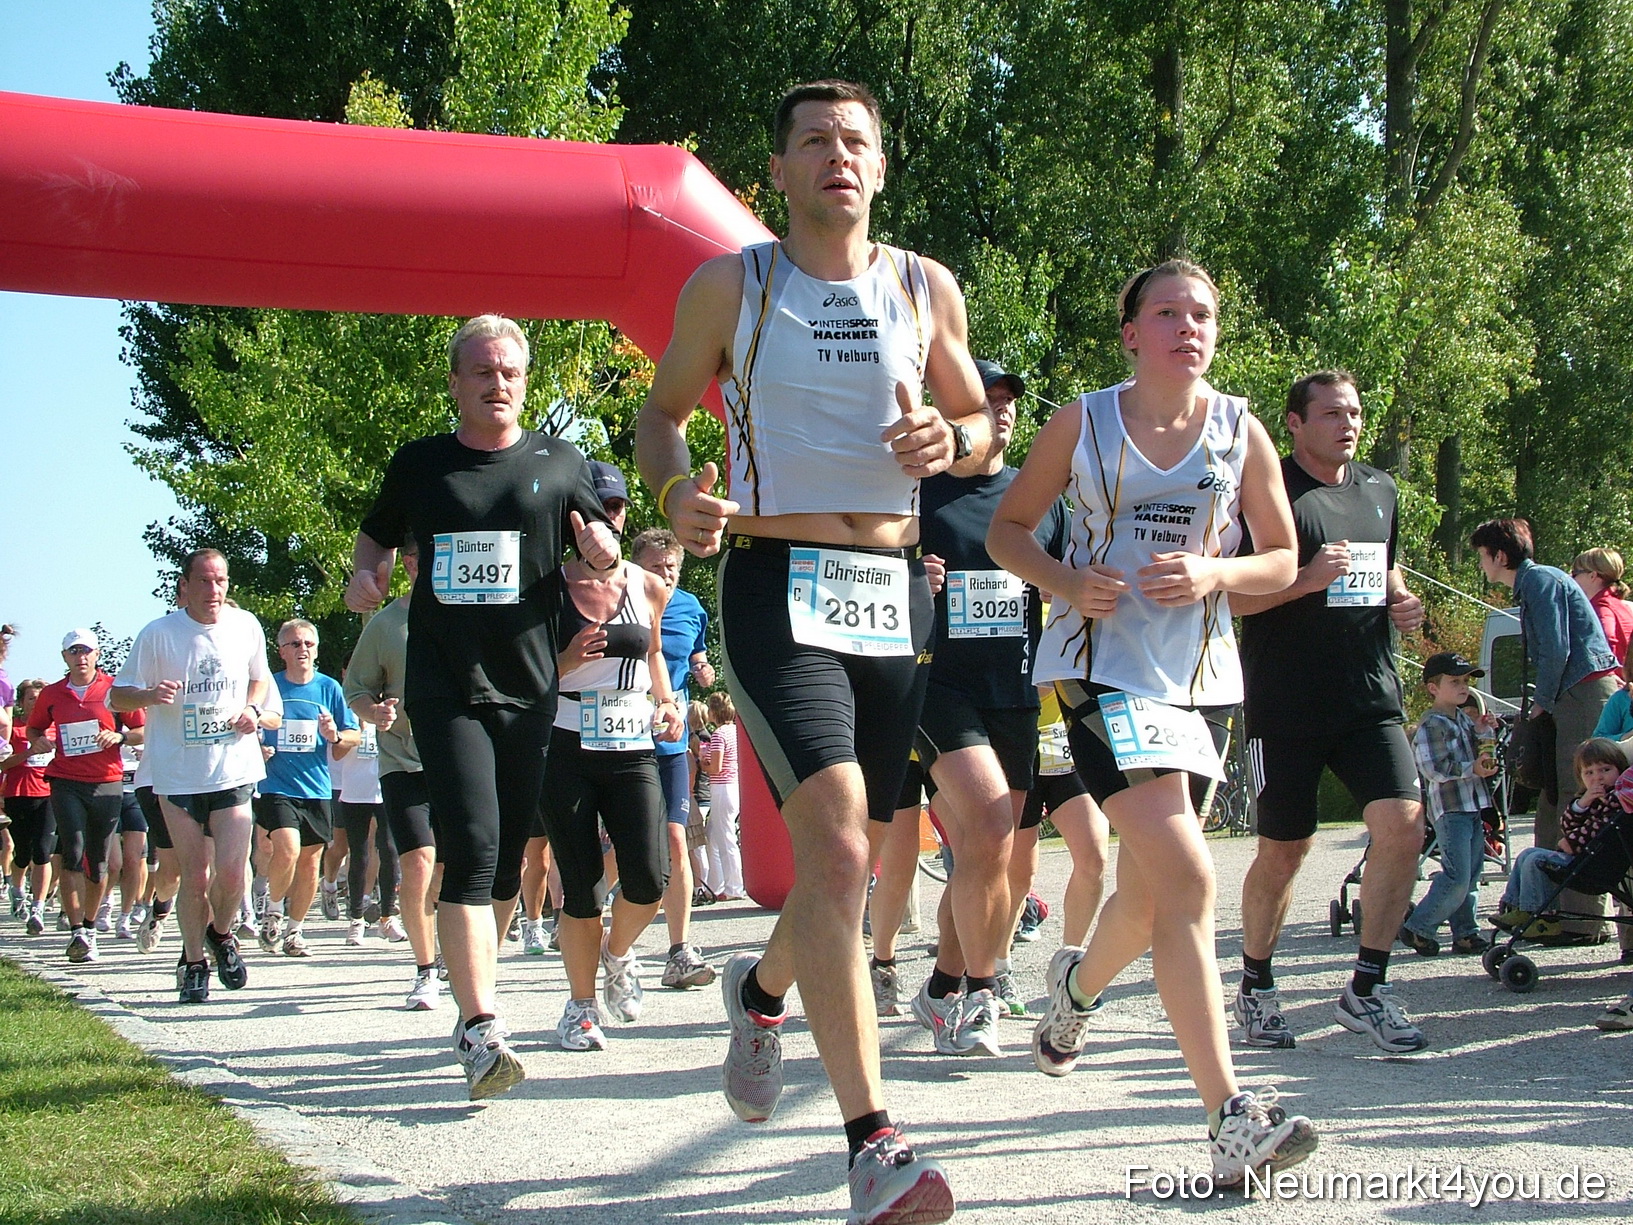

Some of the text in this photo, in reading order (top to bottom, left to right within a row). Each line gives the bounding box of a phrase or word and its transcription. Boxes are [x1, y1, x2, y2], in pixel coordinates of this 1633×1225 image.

[835, 296, 858, 308] asics
[820, 319, 878, 329] INTERSPORT
[813, 330, 878, 340] HACKNER
[817, 348, 880, 364] TV Velburg
[1143, 503, 1197, 515] INTERSPORT
[1134, 513, 1191, 525] HACKNER
[1134, 528, 1187, 546] TV Velburg
[456, 539, 495, 553] Günter
[457, 563, 513, 584] 3497
[823, 559, 892, 586] Christian
[969, 577, 1008, 590] Richard
[1347, 571, 1383, 589] 2788
[793, 587, 801, 602] C
[951, 597, 957, 607] B
[971, 600, 1019, 618] 3029
[824, 597, 900, 631] 2813
[864, 641, 909, 652] PFEIDERER
[603, 717, 644, 734] 3411
[1111, 722, 1120, 734] C
[288, 733, 313, 743] 3691
[1144, 724, 1208, 757] 282
